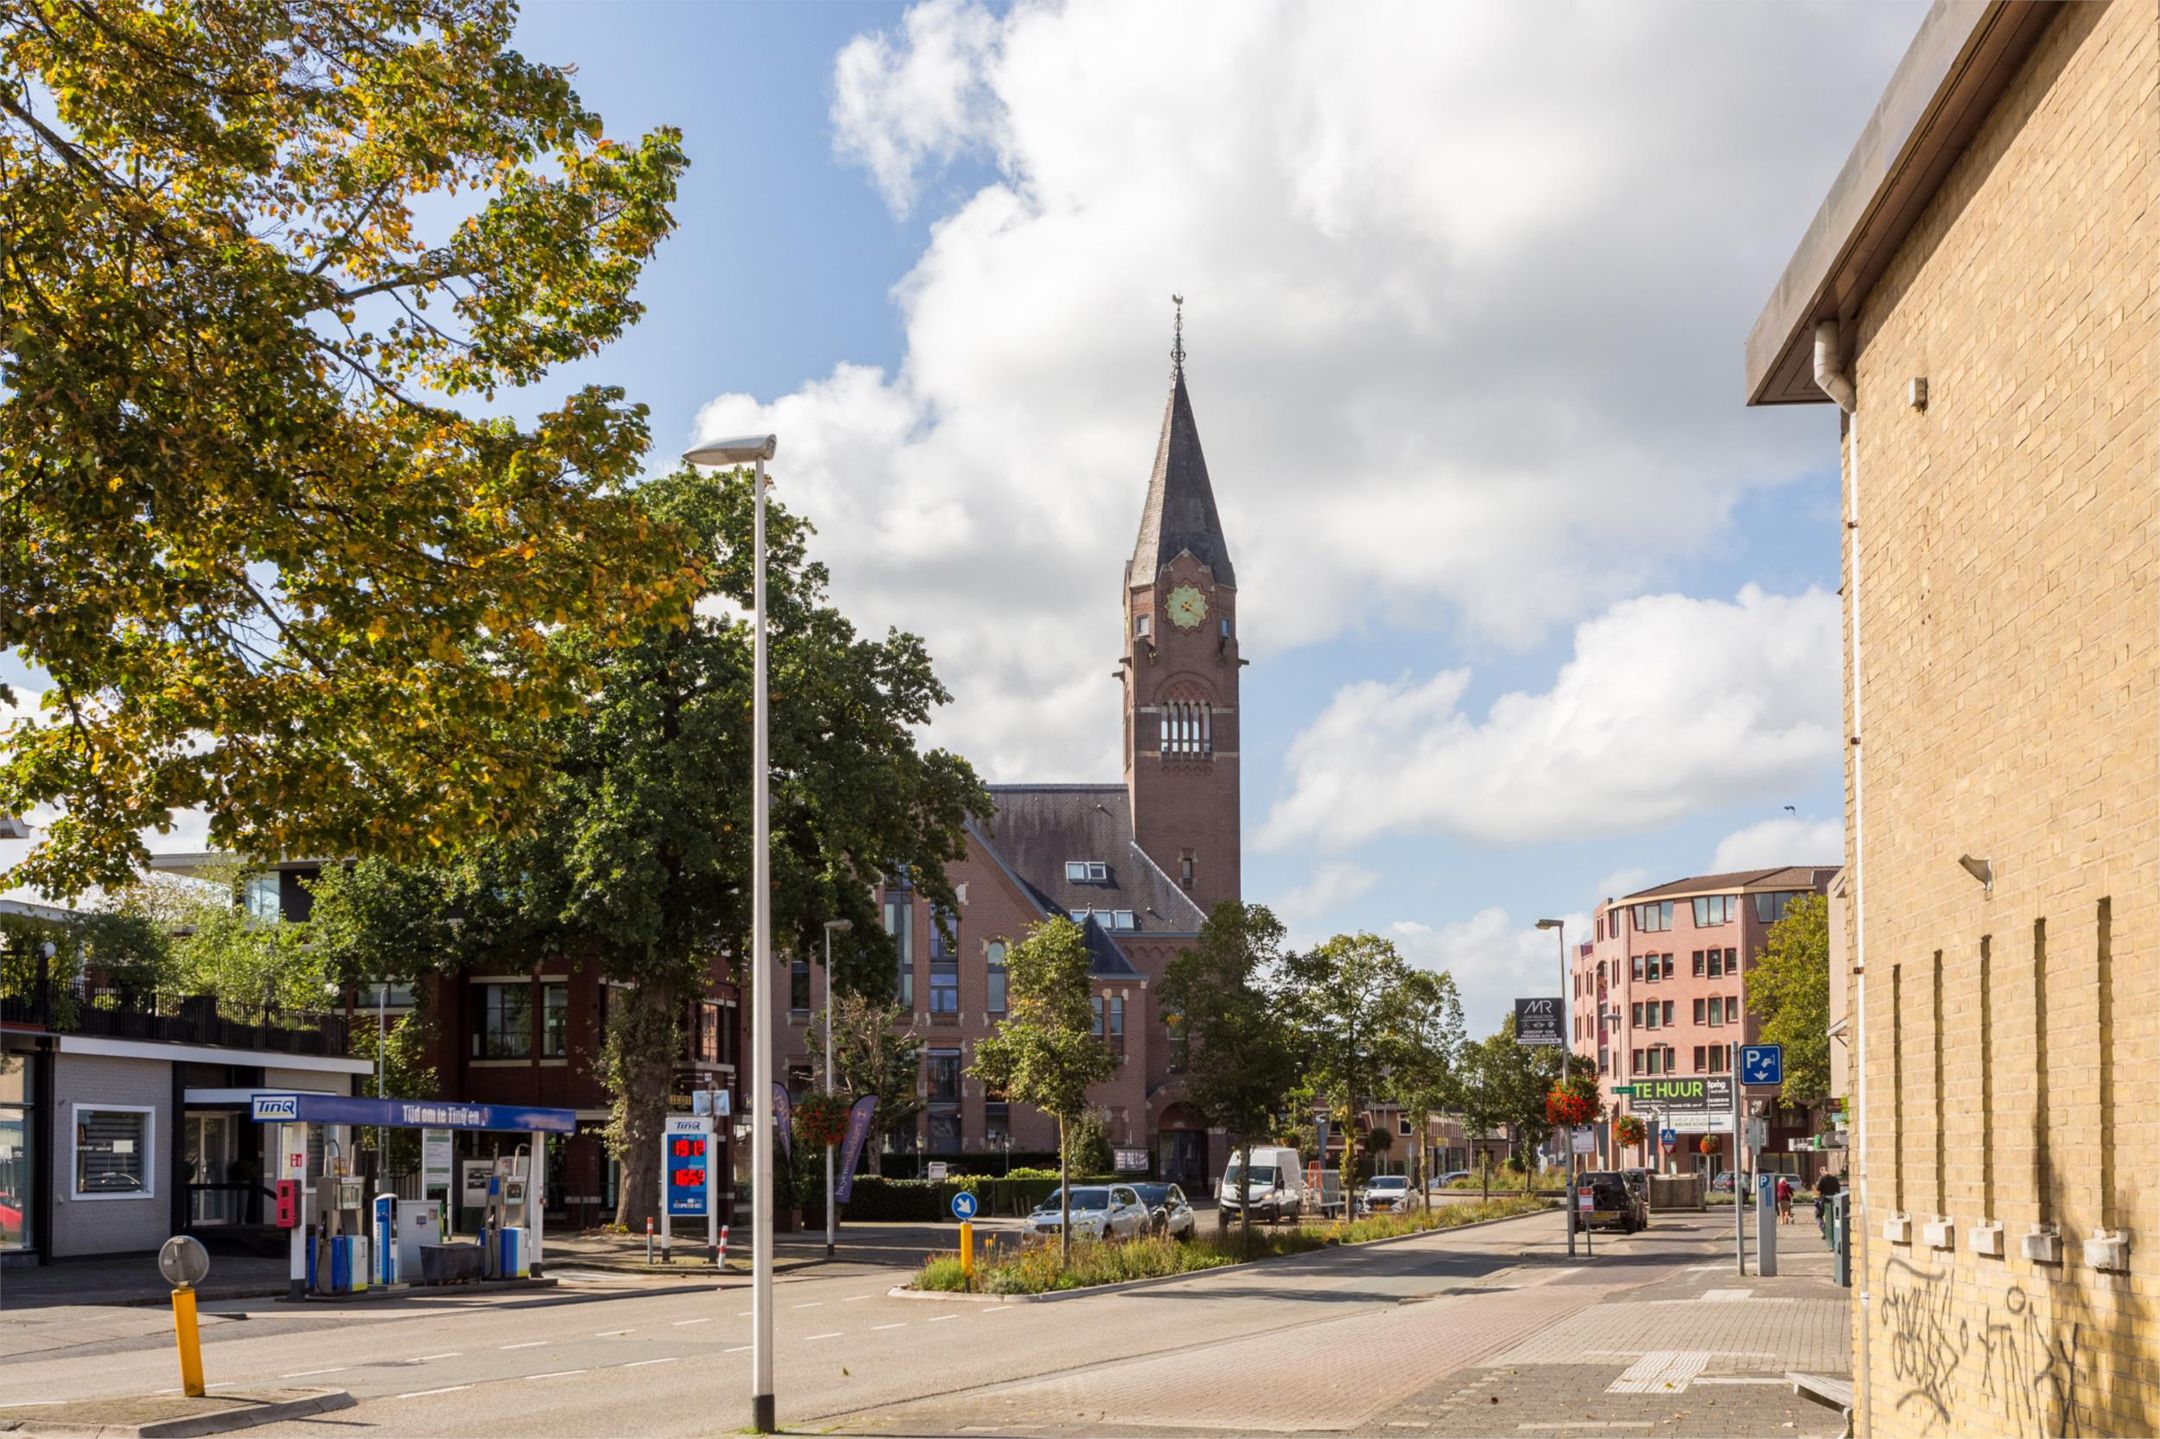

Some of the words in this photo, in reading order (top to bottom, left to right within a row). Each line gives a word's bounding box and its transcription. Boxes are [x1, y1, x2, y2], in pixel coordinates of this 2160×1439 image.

[1746, 1050, 1760, 1069] P
[1633, 1082, 1652, 1098] TE
[1656, 1081, 1703, 1097] HUUR
[256, 1100, 295, 1115] TinQ
[402, 1104, 421, 1124] Tijd
[421, 1108, 436, 1123] om
[437, 1107, 447, 1124] te
[675, 1121, 701, 1130] TinQ
